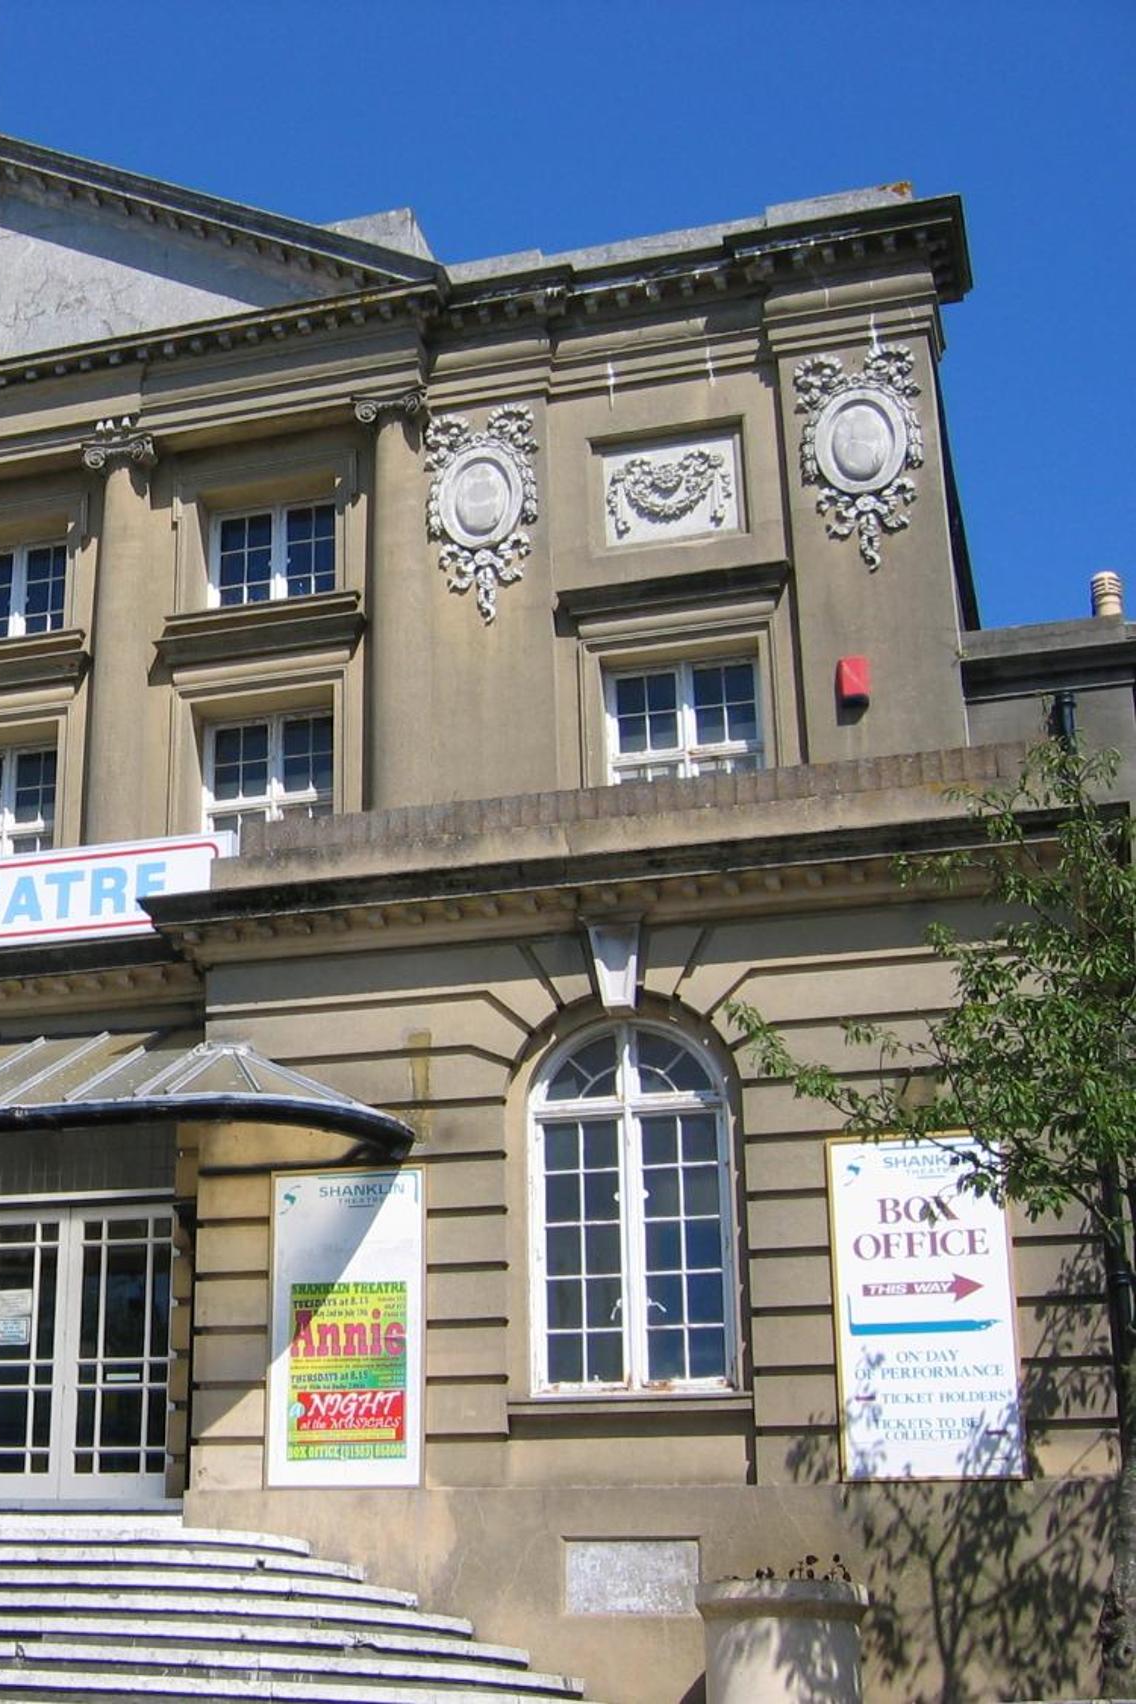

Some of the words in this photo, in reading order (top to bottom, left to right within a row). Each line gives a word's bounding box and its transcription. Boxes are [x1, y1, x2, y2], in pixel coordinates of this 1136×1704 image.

[319, 1183, 405, 1198] SHANKLIN
[877, 1195, 959, 1225] BOX
[853, 1228, 989, 1260] OFFICE
[352, 1282, 406, 1294] THEATRE
[868, 1284, 908, 1296] THIS
[913, 1282, 952, 1293] WAY
[290, 1307, 407, 1357] Annie
[896, 1351, 919, 1364] ON
[926, 1349, 958, 1363] DAY
[291, 1373, 338, 1383] THURSDAYS
[855, 1367, 875, 1380] OF
[881, 1364, 1004, 1380] PERFORMANCE
[307, 1391, 401, 1420] NIGHT
[881, 1392, 930, 1405] TICKET
[329, 1416, 402, 1429] MUSICALS
[875, 1417, 933, 1431] TICKETS
[935, 1417, 956, 1429] TO
[961, 1416, 980, 1429] BE
[885, 1429, 968, 1441] COLLECTED
